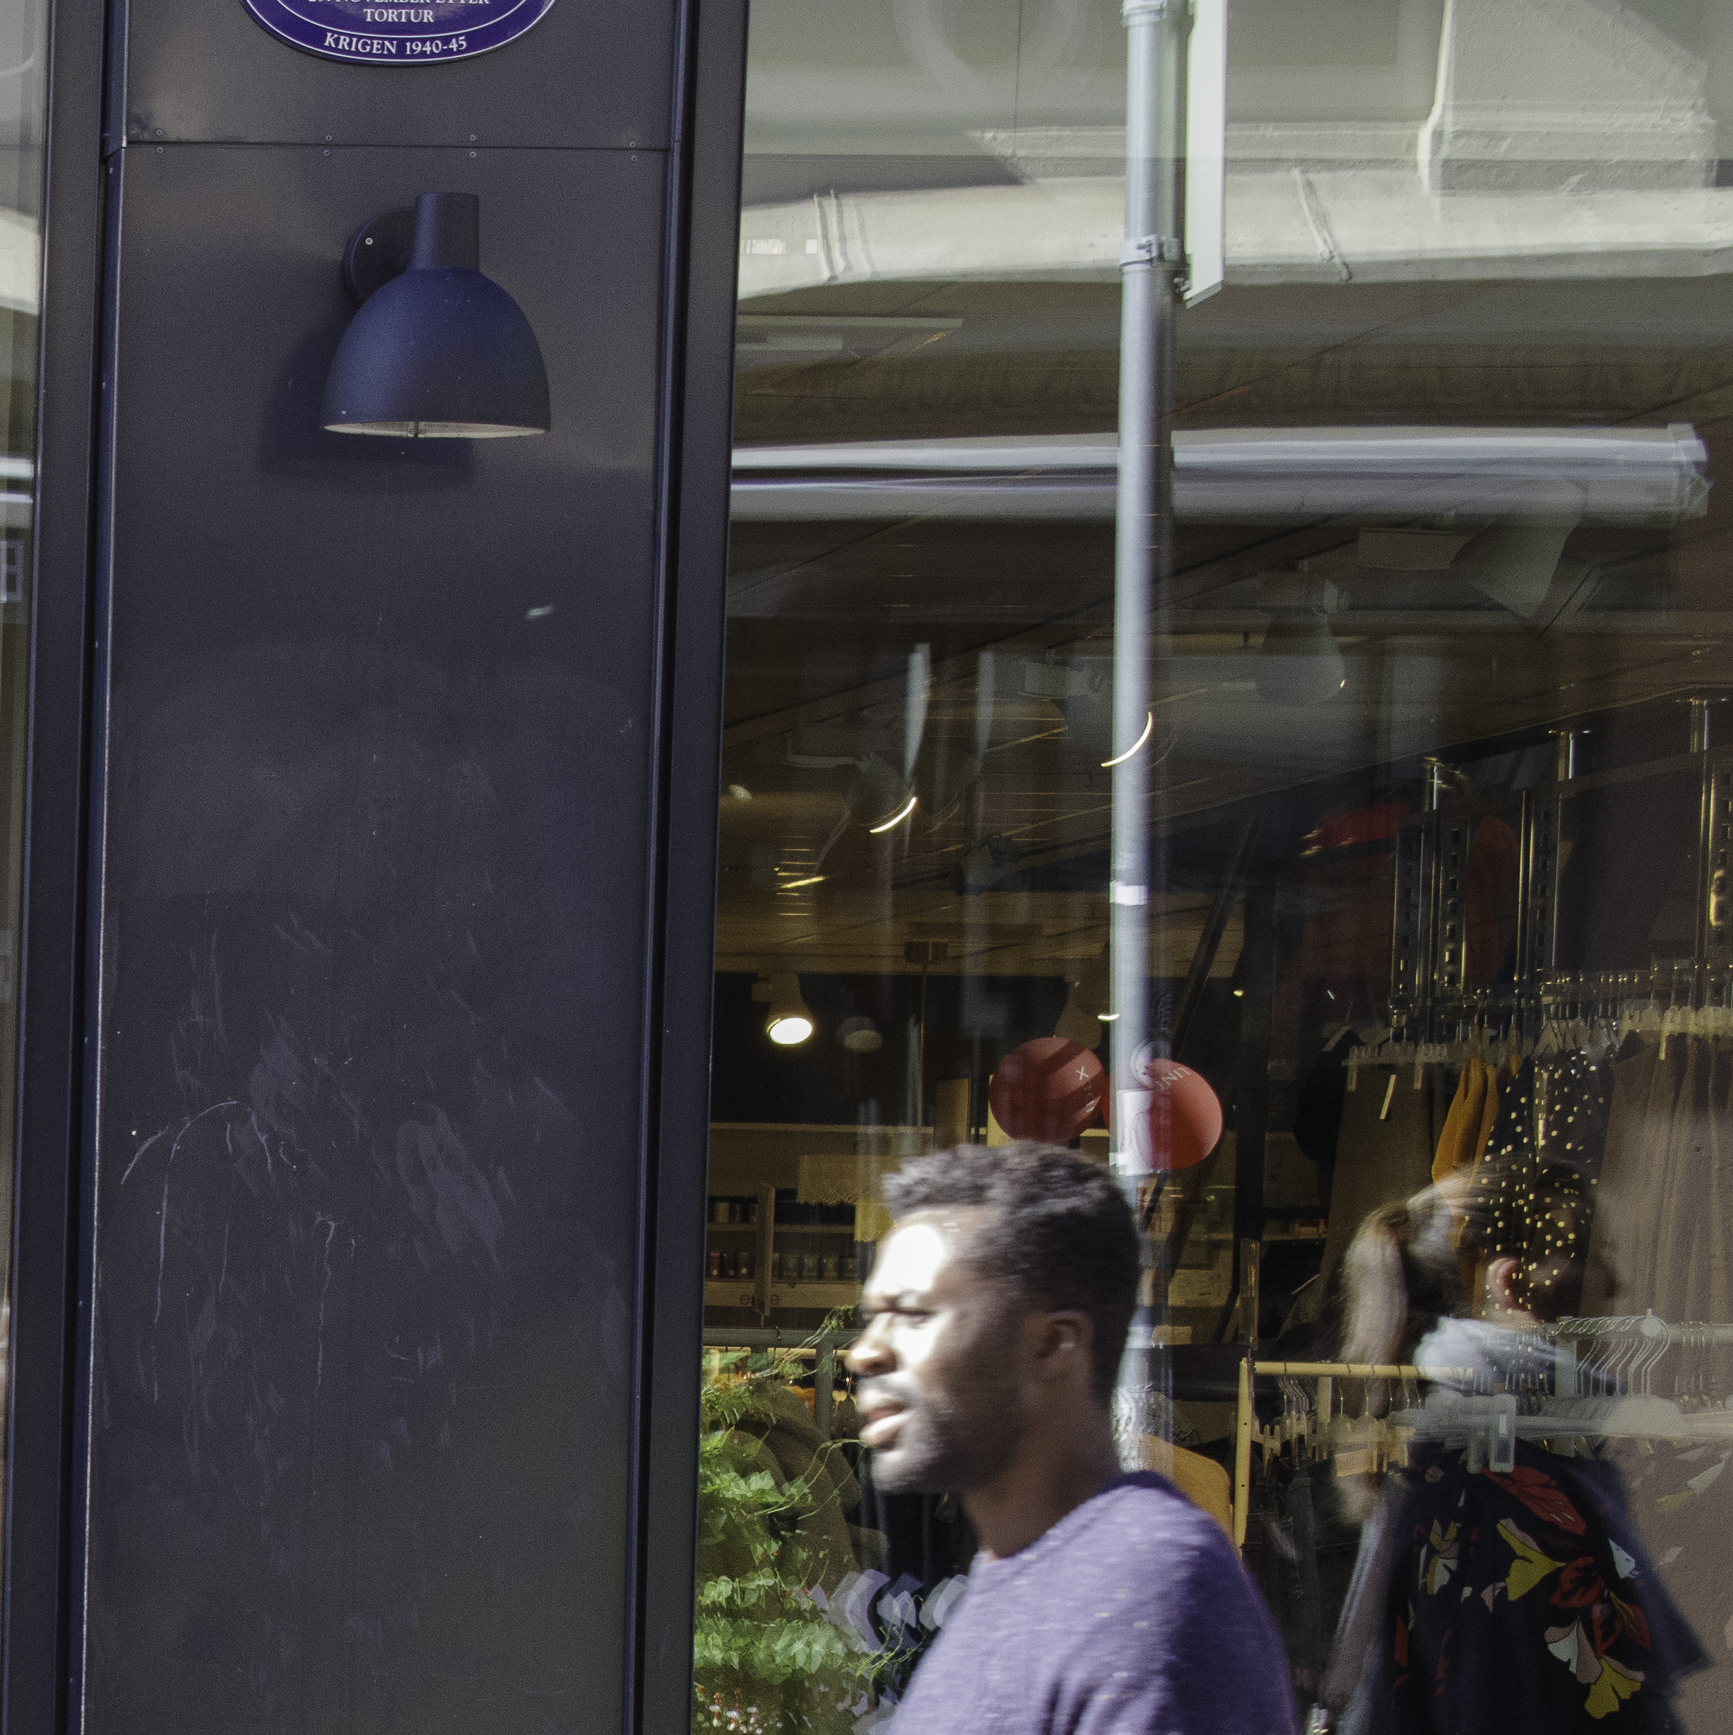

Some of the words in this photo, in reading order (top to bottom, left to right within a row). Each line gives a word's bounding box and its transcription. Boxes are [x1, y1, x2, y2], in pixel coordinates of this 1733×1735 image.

[363, 8, 434, 23] TORTUR
[323, 32, 397, 55] KRIGEN
[405, 36, 467, 55] 1940-45
